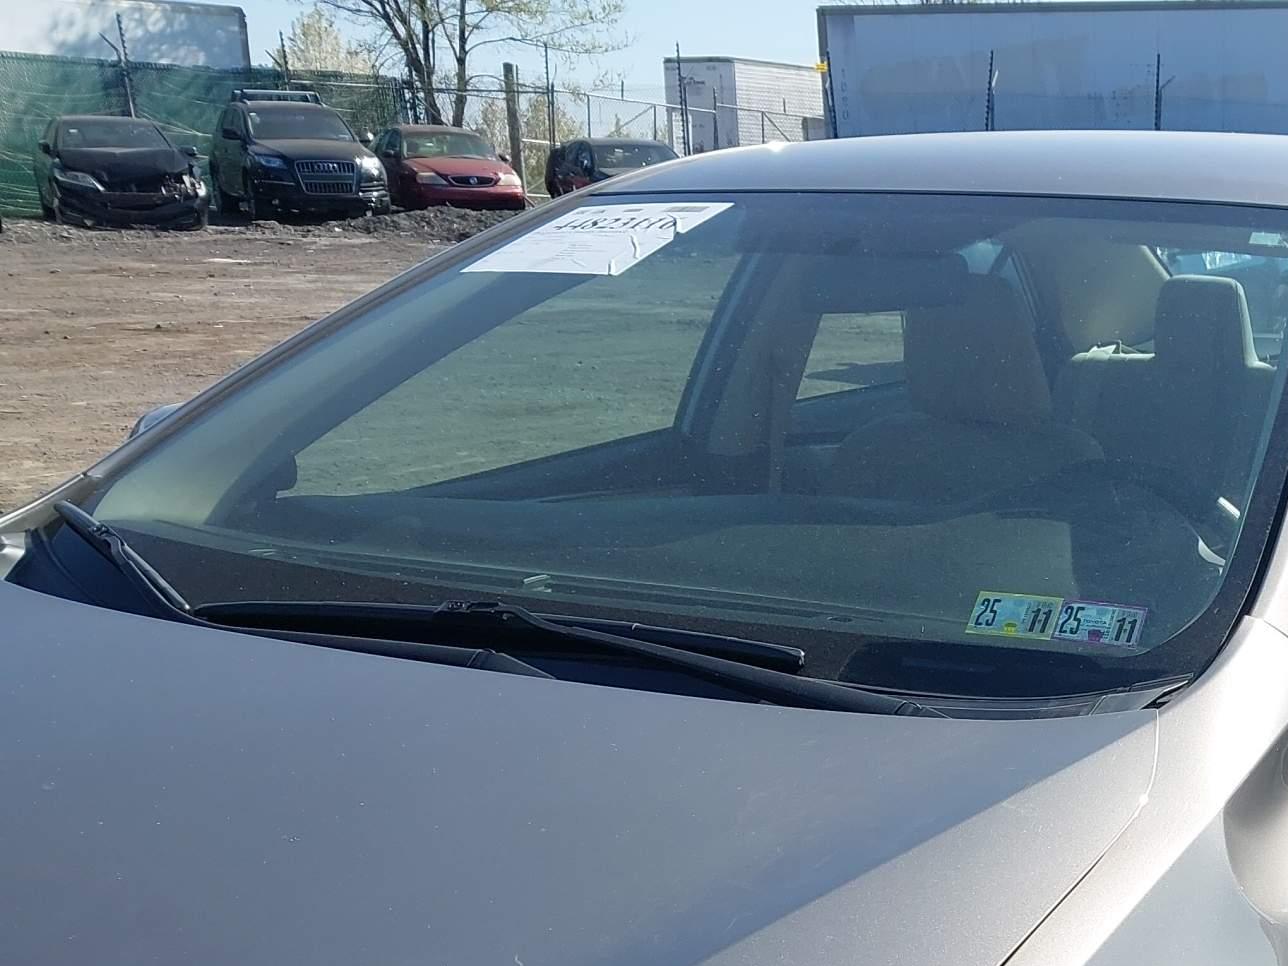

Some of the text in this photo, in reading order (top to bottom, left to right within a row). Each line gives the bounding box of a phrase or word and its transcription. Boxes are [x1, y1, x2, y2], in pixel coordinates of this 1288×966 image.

[974, 598, 1002, 627] 25
[1028, 607, 1053, 634] 11
[1058, 605, 1086, 635] 25
[1114, 616, 1138, 643] 11
